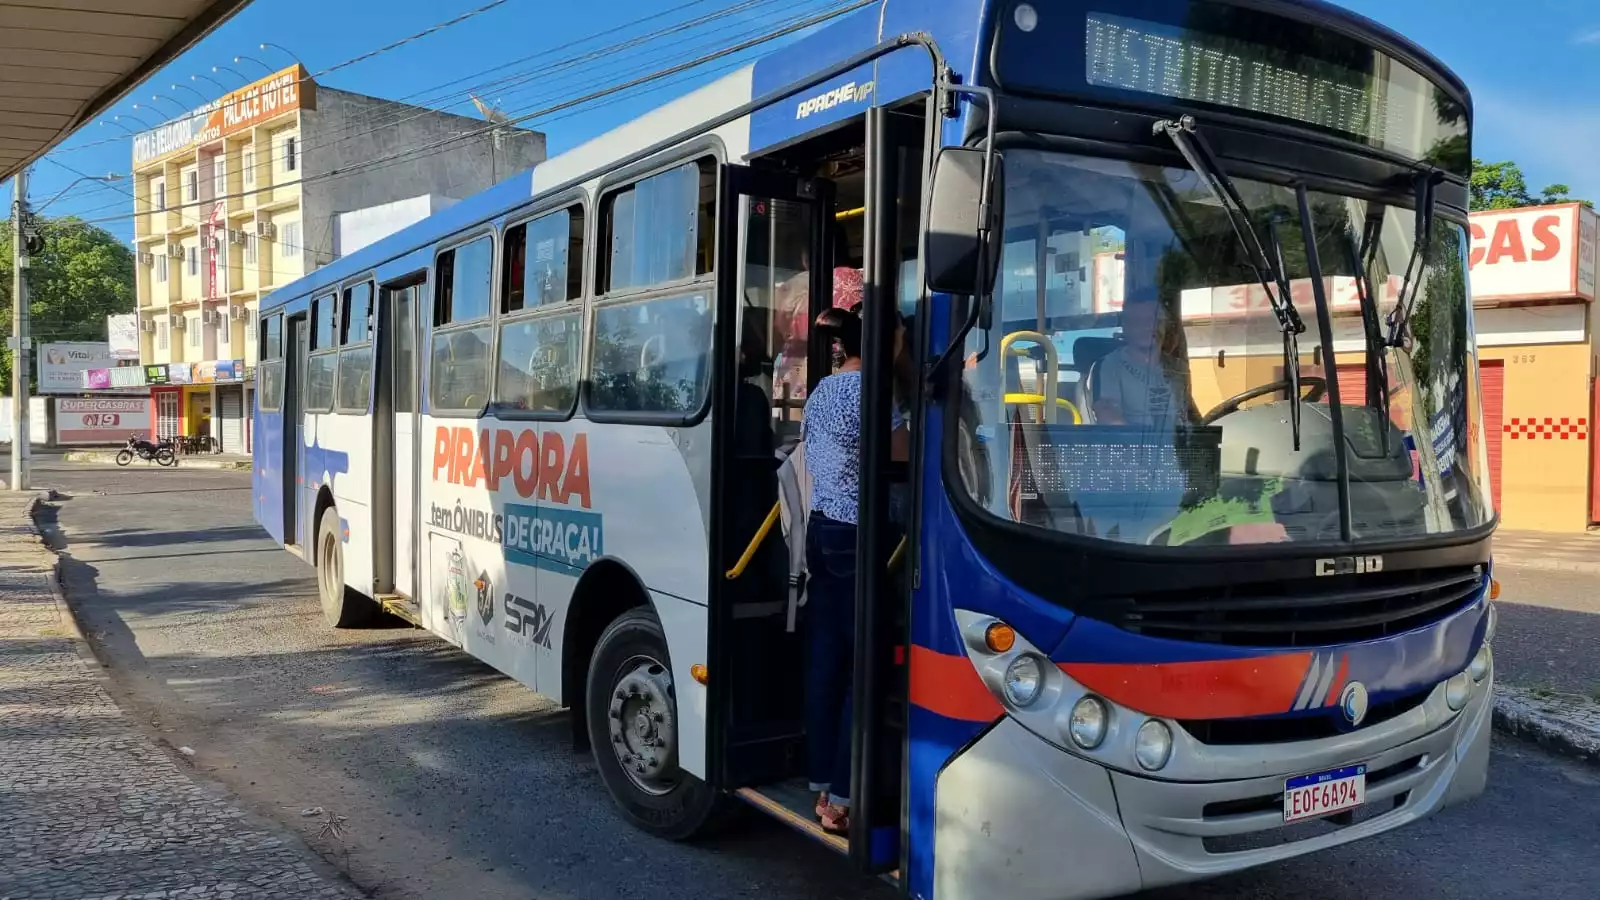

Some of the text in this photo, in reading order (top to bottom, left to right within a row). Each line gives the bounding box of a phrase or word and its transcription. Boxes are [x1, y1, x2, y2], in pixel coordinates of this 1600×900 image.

[223, 72, 297, 129] PALACE HOTEL
[796, 81, 875, 120] APACHE VIP
[432, 426, 592, 509] PIRAPORA
[431, 497, 599, 569] tem ÔNIBUS DE GRAÇA!
